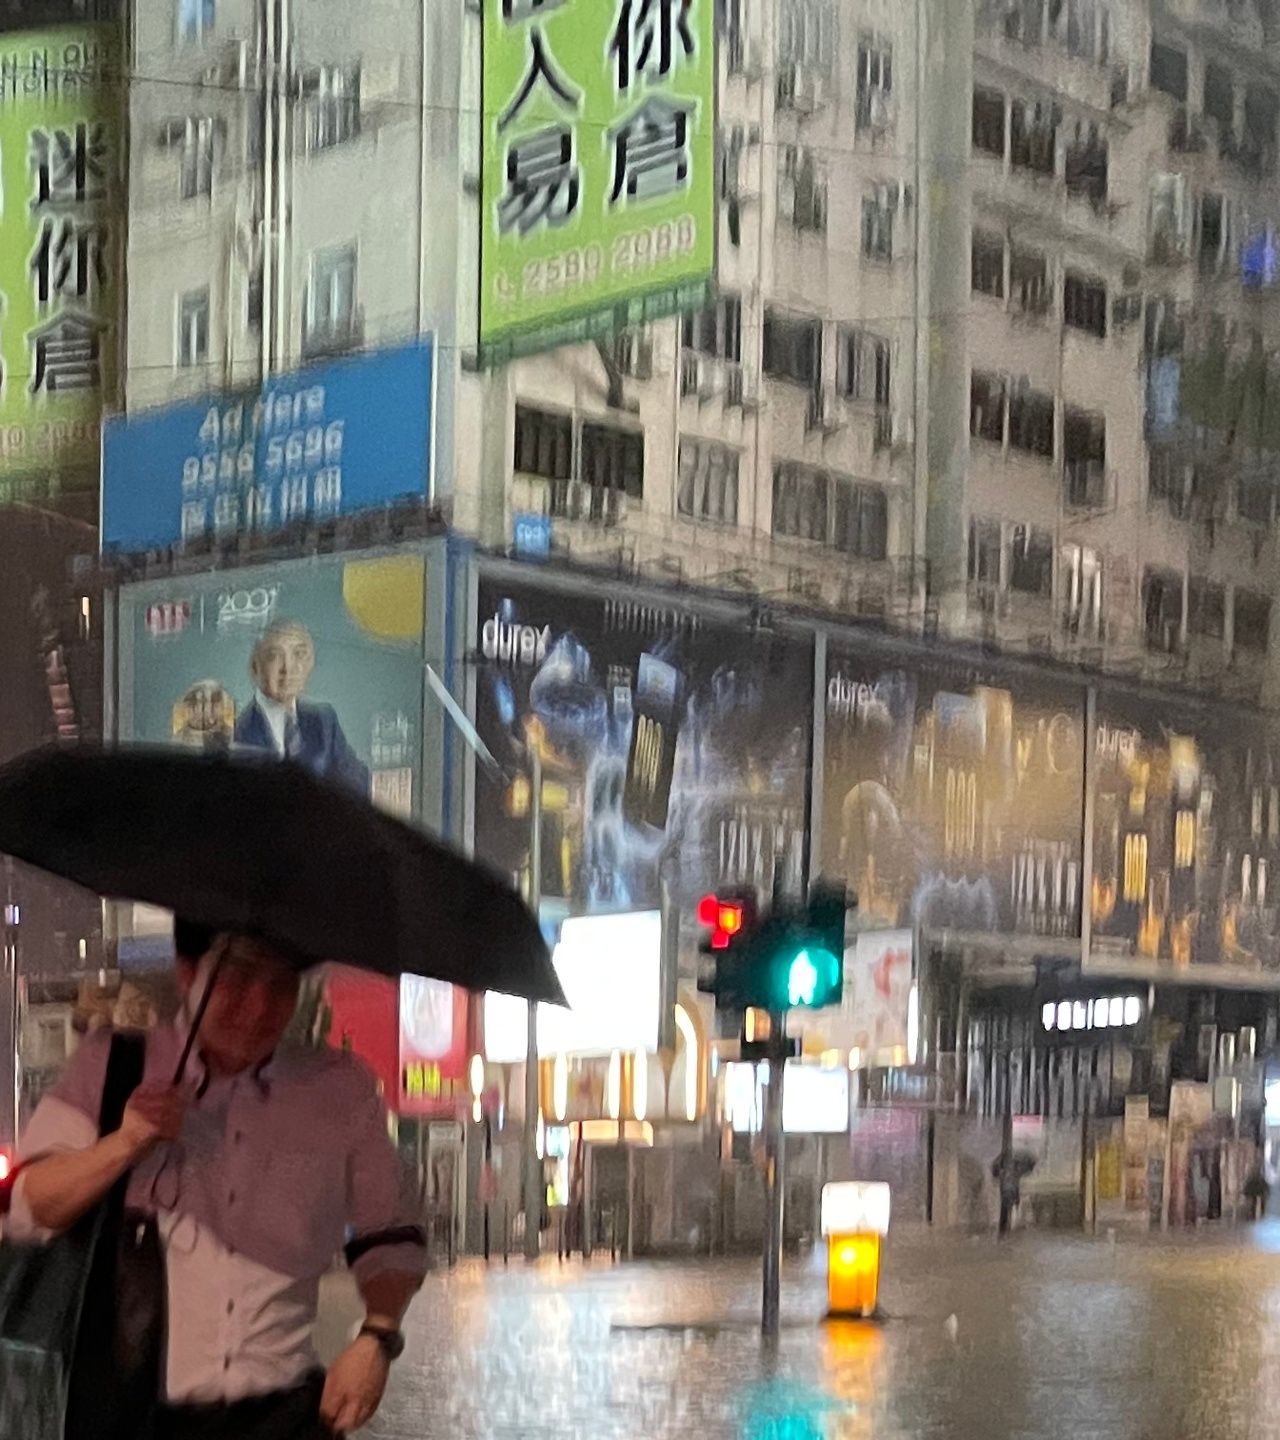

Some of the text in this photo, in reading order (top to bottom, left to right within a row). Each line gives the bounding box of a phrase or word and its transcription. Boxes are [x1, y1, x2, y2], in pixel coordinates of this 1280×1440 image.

[28, 120, 114, 398] 迷你倉
[482, 612, 551, 667] durex
[827, 671, 879, 711] durex
